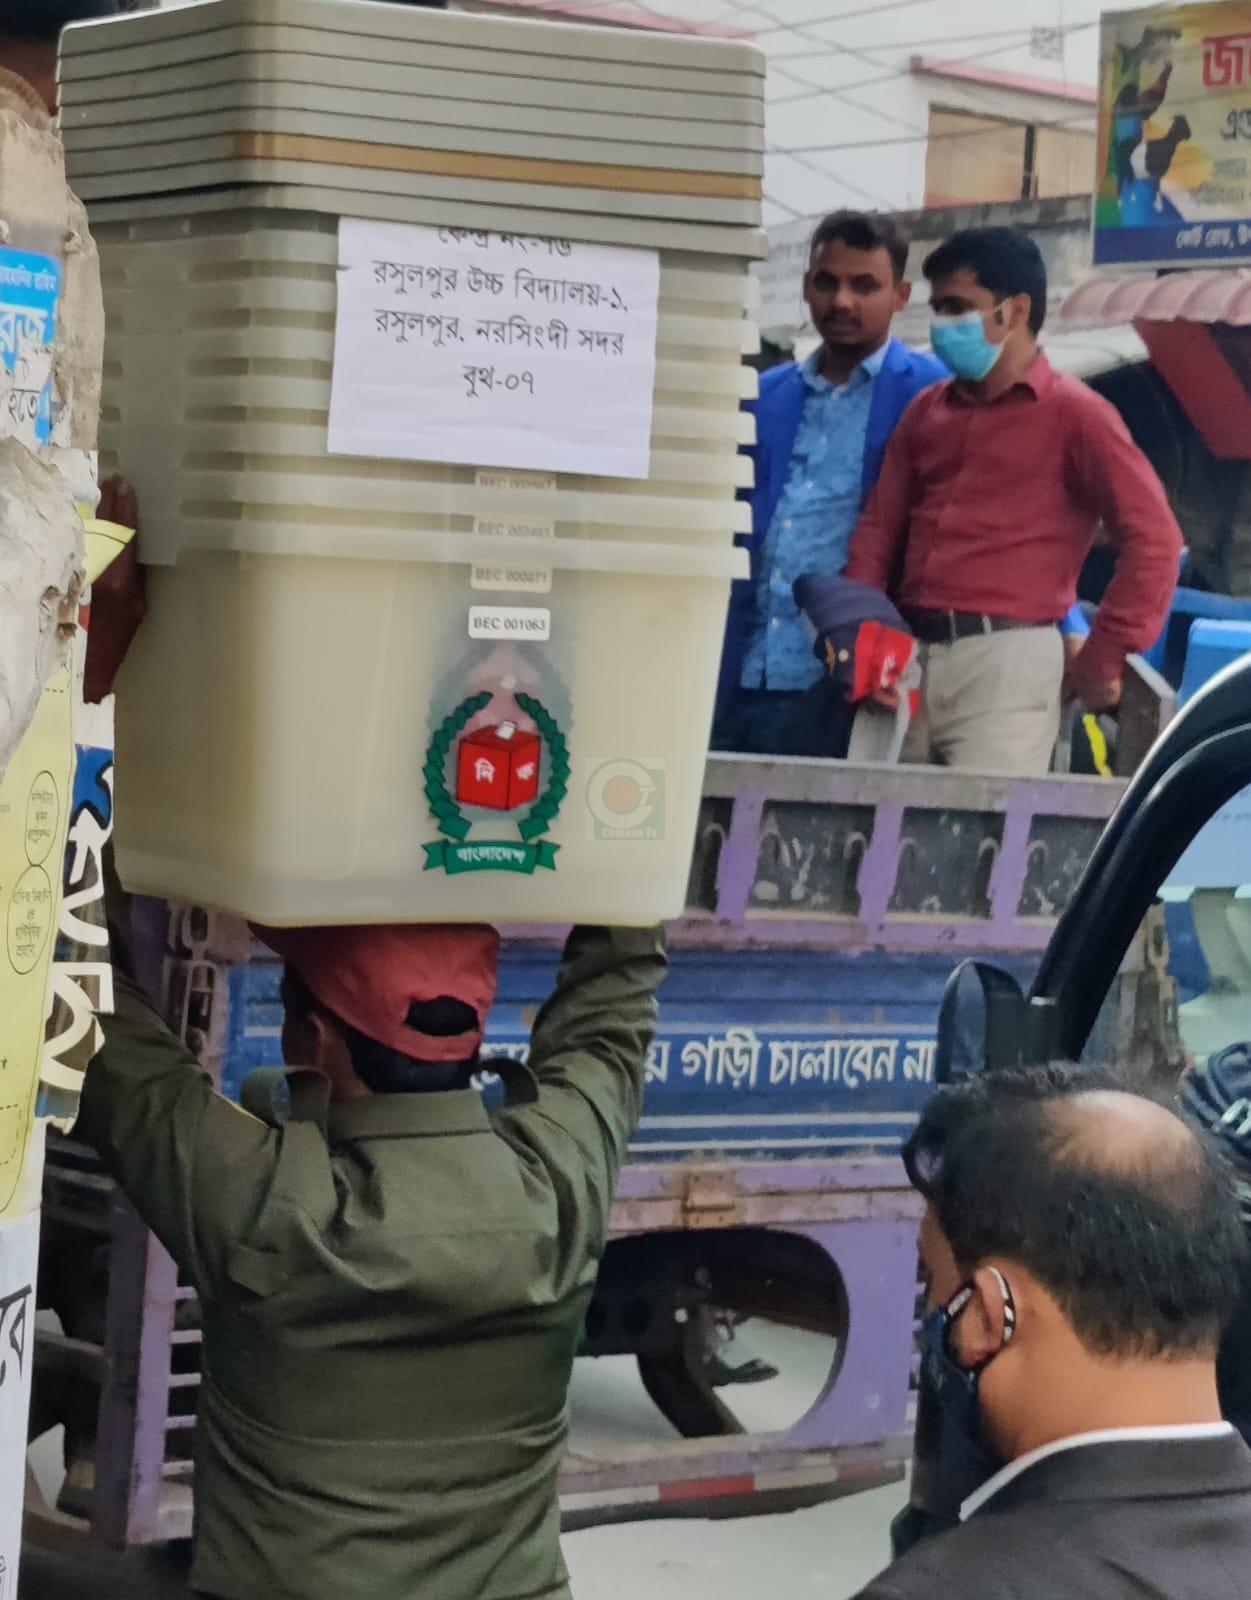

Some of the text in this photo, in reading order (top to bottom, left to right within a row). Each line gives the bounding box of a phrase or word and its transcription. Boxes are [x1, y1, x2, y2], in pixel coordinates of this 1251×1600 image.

[1202, 32, 1251, 90] জা
[371, 259, 458, 299] রসুলপুর
[467, 263, 505, 295] উচ্চ
[475, 314, 569, 351] নরসিংদী
[577, 328, 625, 356] সদর
[462, 363, 535, 398] বুথ-০৭
[473, 616, 546, 632] BEC 001063
[456, 845, 527, 865] বাংলাদেশ
[680, 1026, 763, 1089] গাড়ী
[767, 1038, 900, 1089] চালাবেন
[903, 1038, 938, 1084] না
